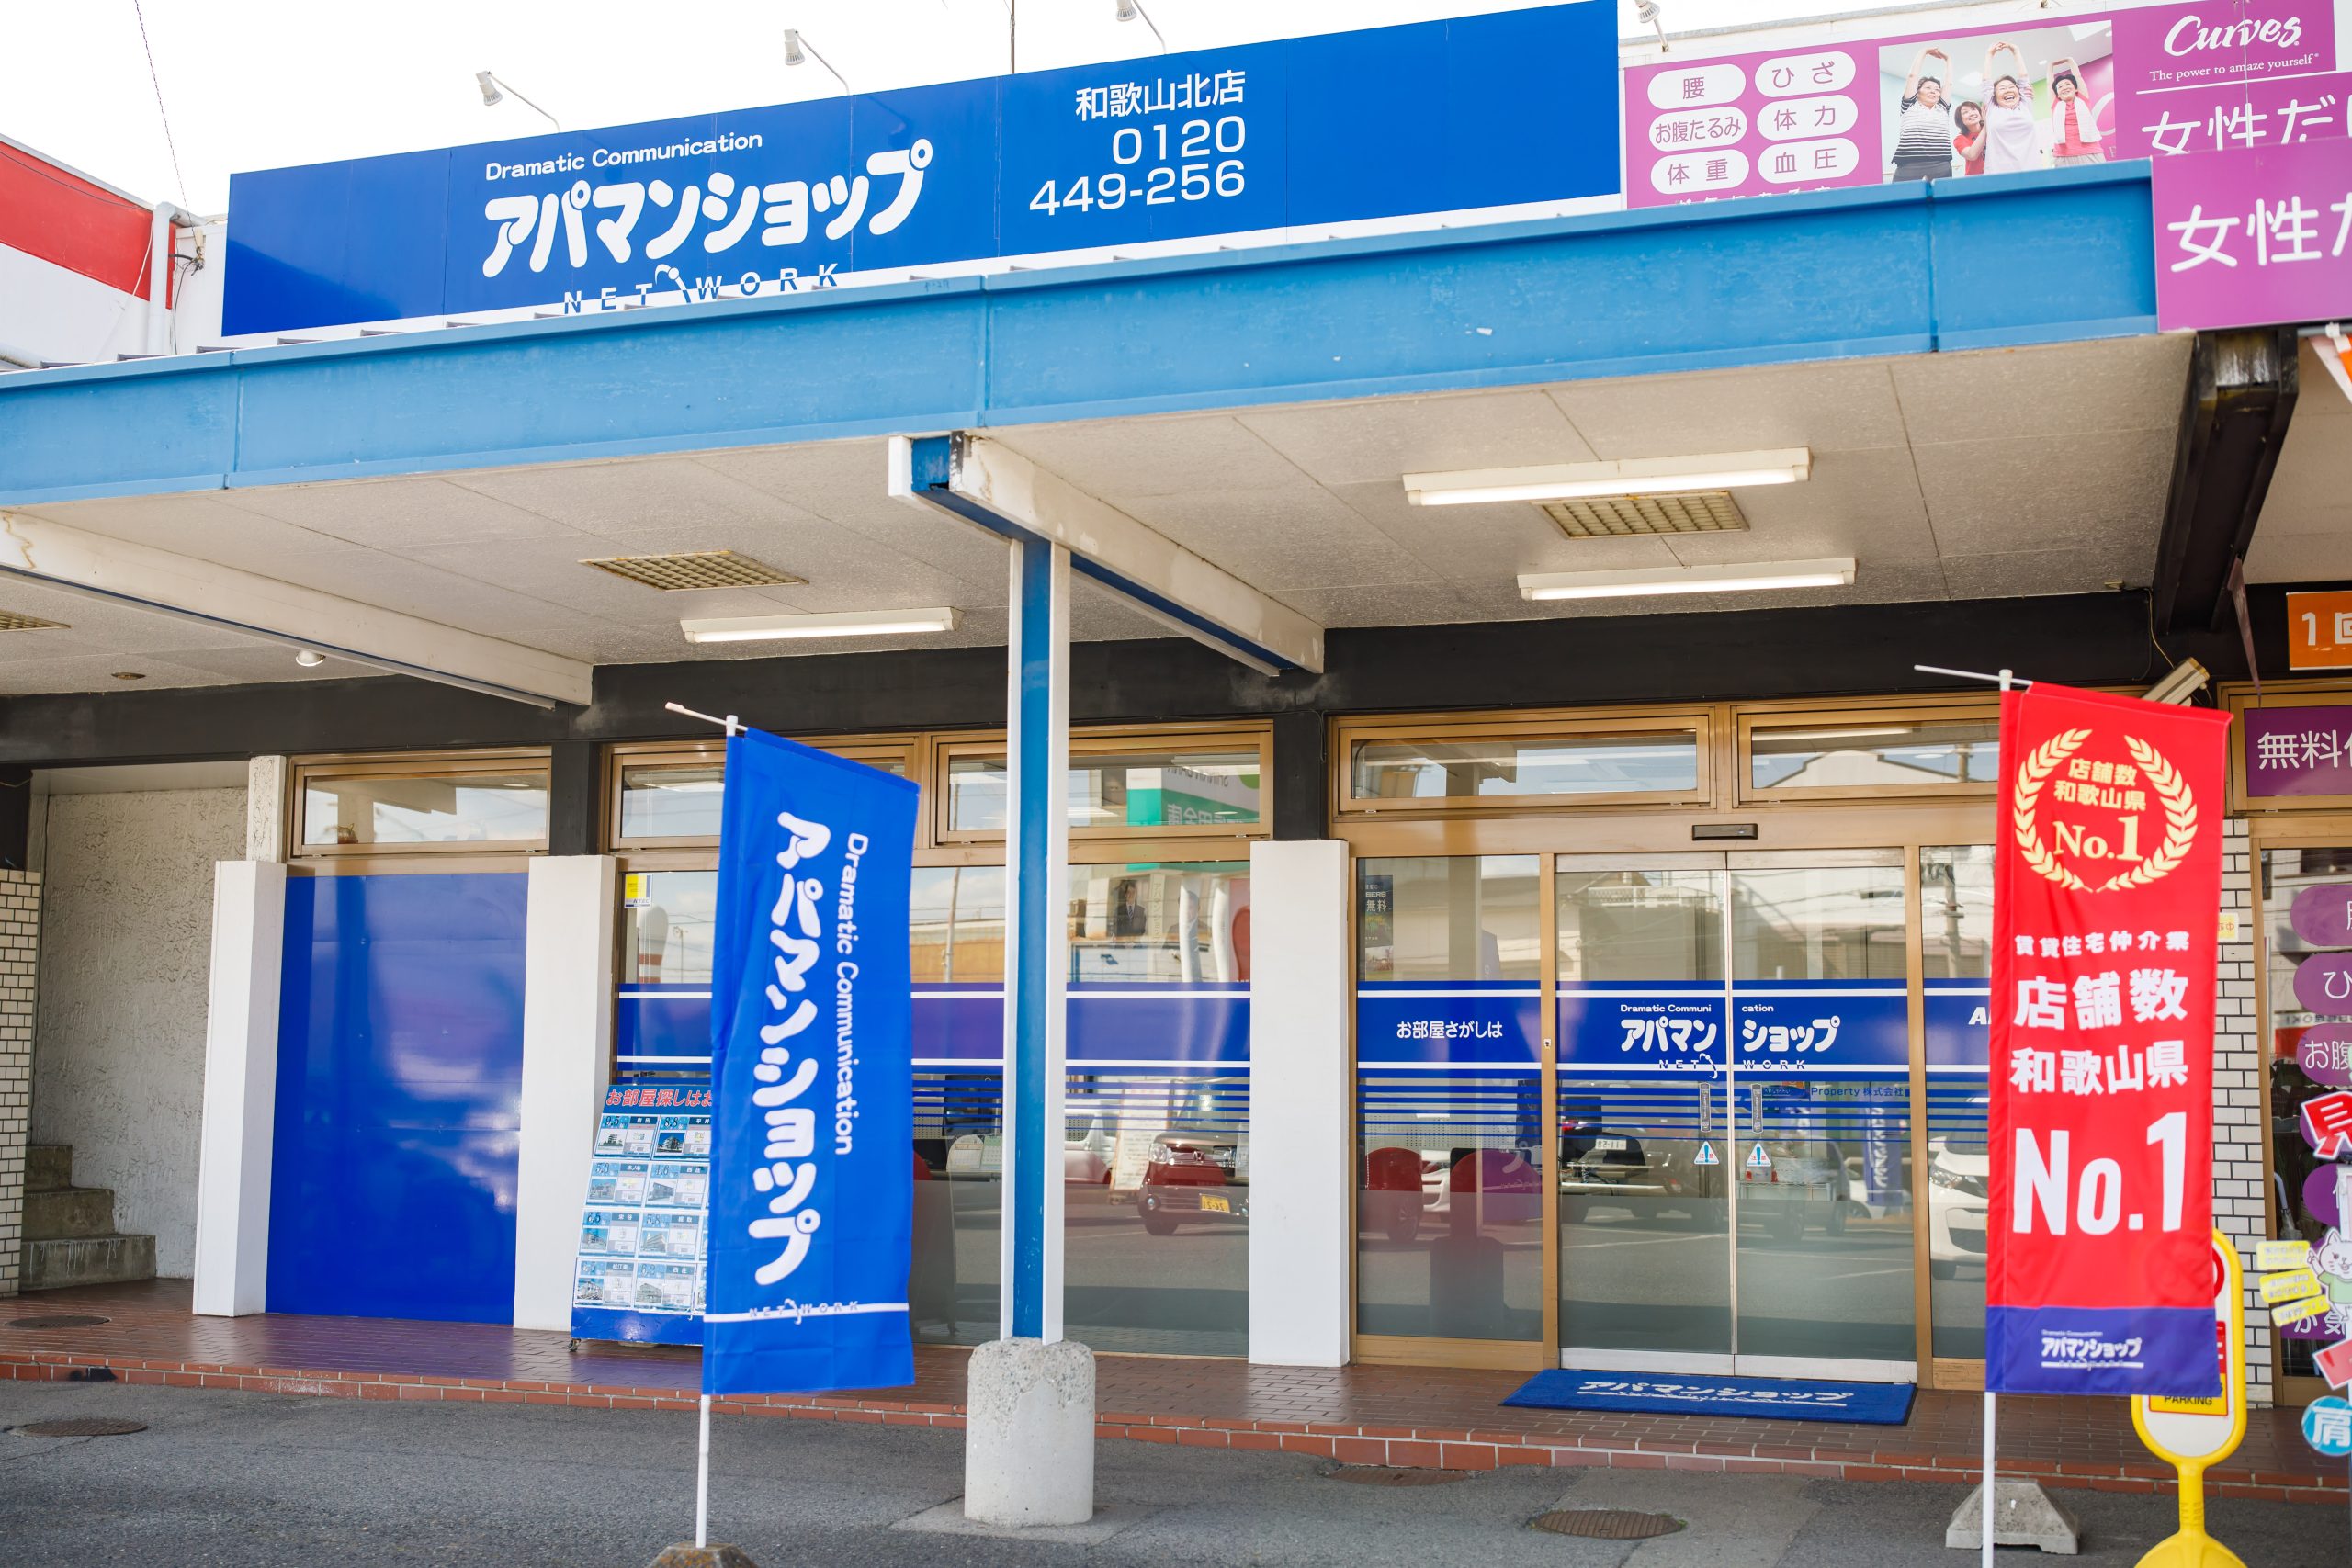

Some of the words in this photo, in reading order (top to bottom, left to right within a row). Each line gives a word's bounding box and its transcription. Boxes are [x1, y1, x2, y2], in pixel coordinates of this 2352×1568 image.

[2164, 15, 2302, 56] Curves
[1771, 61, 1836, 89] ひざ
[2149, 70, 2173, 82] The
[2176, 66, 2211, 82] power
[2214, 63, 2226, 74] to
[2229, 61, 2265, 73] amaze
[2267, 53, 2315, 71] yourself
[1075, 69, 1246, 123] 和歌山北店
[1681, 76, 1705, 100] 腰
[1655, 116, 1742, 144] お腹たるみ
[1773, 105, 1837, 132] 体力
[485, 152, 585, 182] Dramatic
[592, 130, 763, 167] Communication
[1112, 116, 1246, 166] 0120
[1667, 157, 1729, 186] 体重
[1773, 147, 1838, 175] 血圧
[1028, 160, 1247, 218] 449-256
[482, 137, 933, 278] アパマンショップ
[2068, 757, 2138, 787] 店舗数
[2053, 779, 2147, 812] 和歌山県
[2052, 815, 2144, 862] No.1
[835, 830, 869, 955] Dramatic
[2014, 930, 2190, 959] 賃貸住宅仲介業
[1620, 1003, 1666, 1013] Dramatic
[1668, 1003, 1712, 1013] Communi
[1741, 1004, 1774, 1013] cation
[2013, 968, 2189, 1031] 店舗数
[1396, 1020, 1504, 1040] お部屋さがしは
[1621, 1015, 1717, 1052] アパマン
[1742, 1015, 1841, 1053] ショップ
[747, 810, 831, 1286] アパマンショップ
[833, 960, 859, 1157] Communication
[1743, 1059, 1806, 1071] WORK
[2009, 1040, 2189, 1096] 和歌山県
[1811, 1087, 1860, 1097] Property
[1863, 1087, 1904, 1097] 株式会社
[2012, 1111, 2188, 1235] No.1
[2041, 1337, 2143, 1359] アパマンショップ
[1579, 1381, 1854, 1401] アパマンショップ
